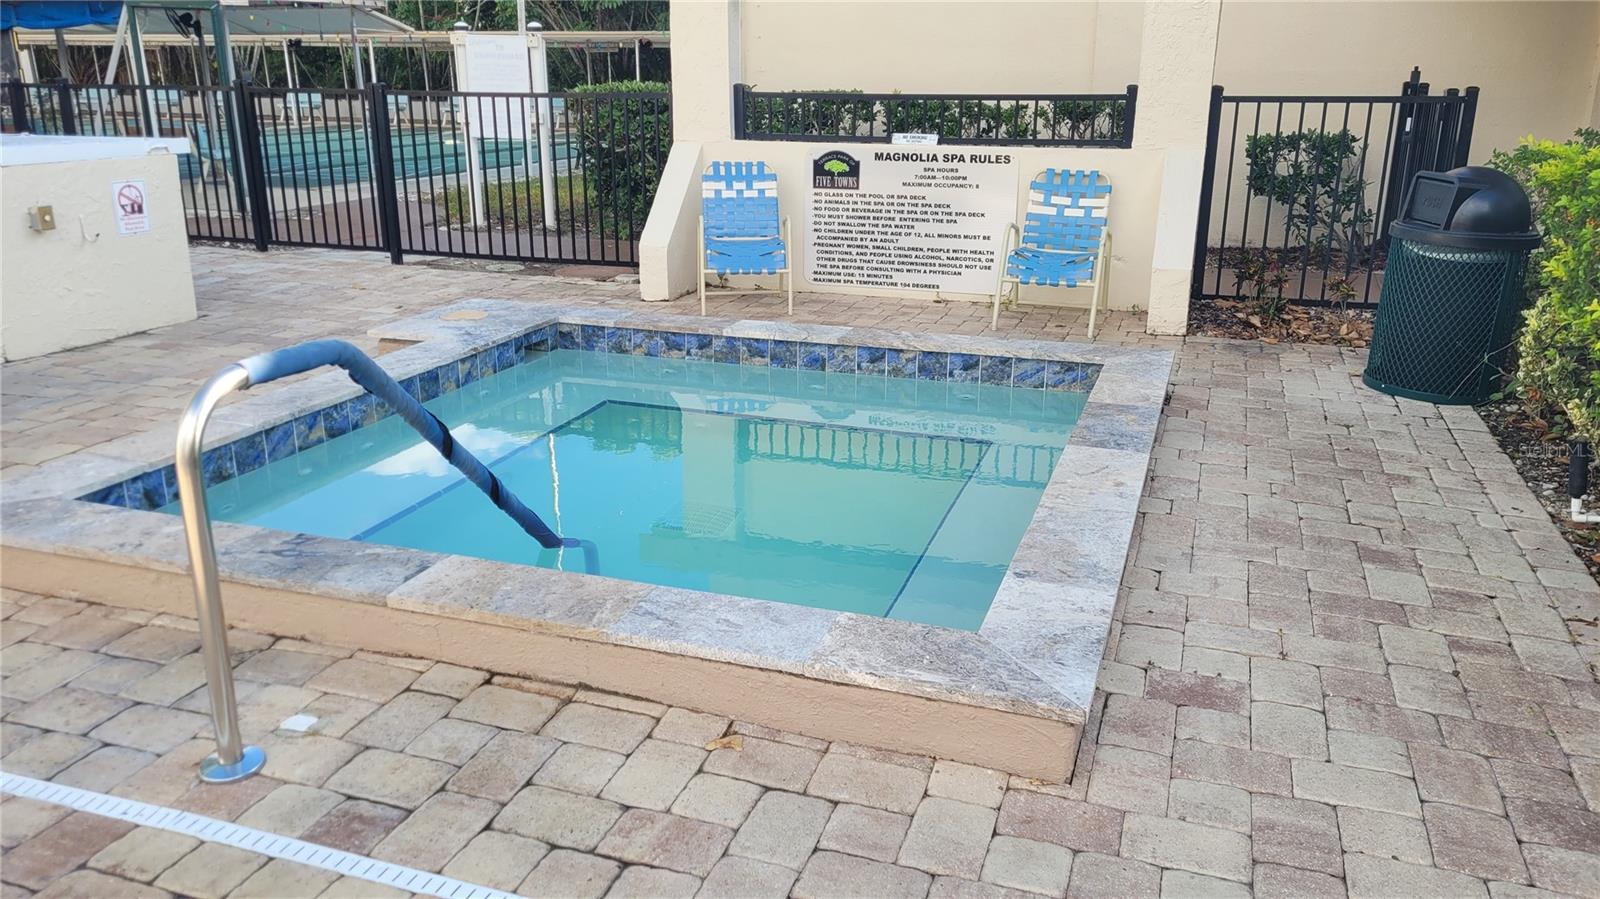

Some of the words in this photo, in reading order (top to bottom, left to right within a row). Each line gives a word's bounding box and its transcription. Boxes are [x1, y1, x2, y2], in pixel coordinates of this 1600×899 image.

[874, 152, 938, 162] MAGNOLIA
[942, 154, 965, 163] SPA
[969, 154, 1010, 164] RULES
[816, 176, 831, 187] FIVE
[834, 176, 857, 188] TOWNS
[855, 279, 898, 287] TEMPERATURE
